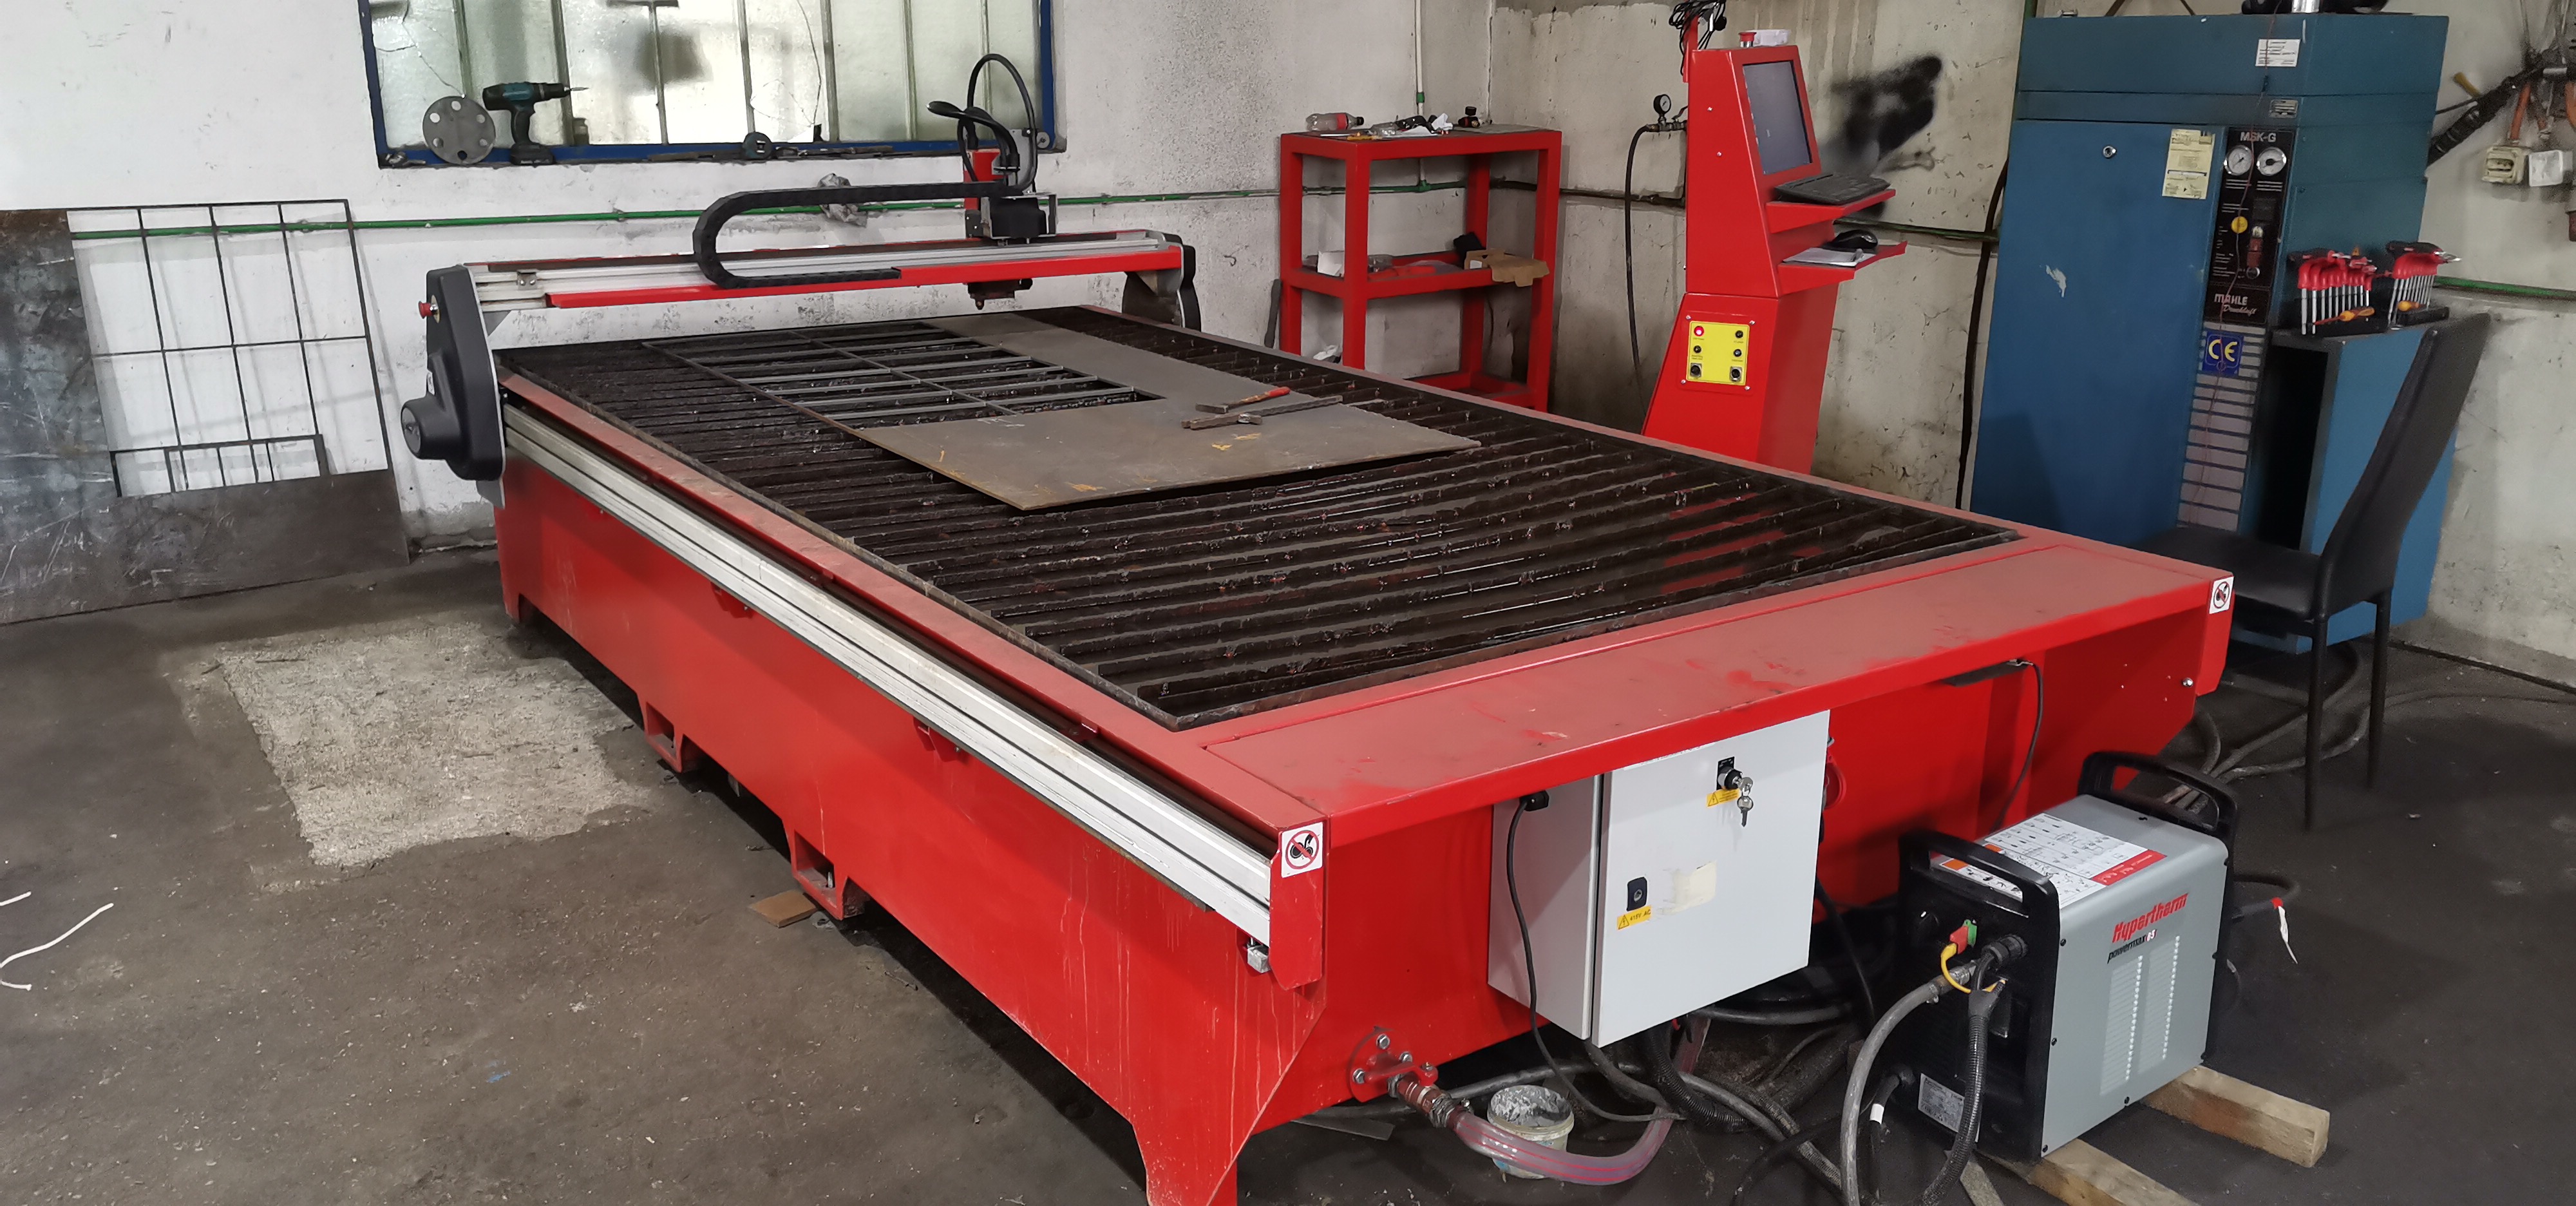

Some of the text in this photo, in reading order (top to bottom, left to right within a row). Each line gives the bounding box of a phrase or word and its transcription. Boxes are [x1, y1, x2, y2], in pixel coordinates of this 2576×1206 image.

[2214, 293, 2248, 305] MAHLE
[2208, 339, 2238, 362] CE
[2112, 893, 2188, 943] Hypertherm
